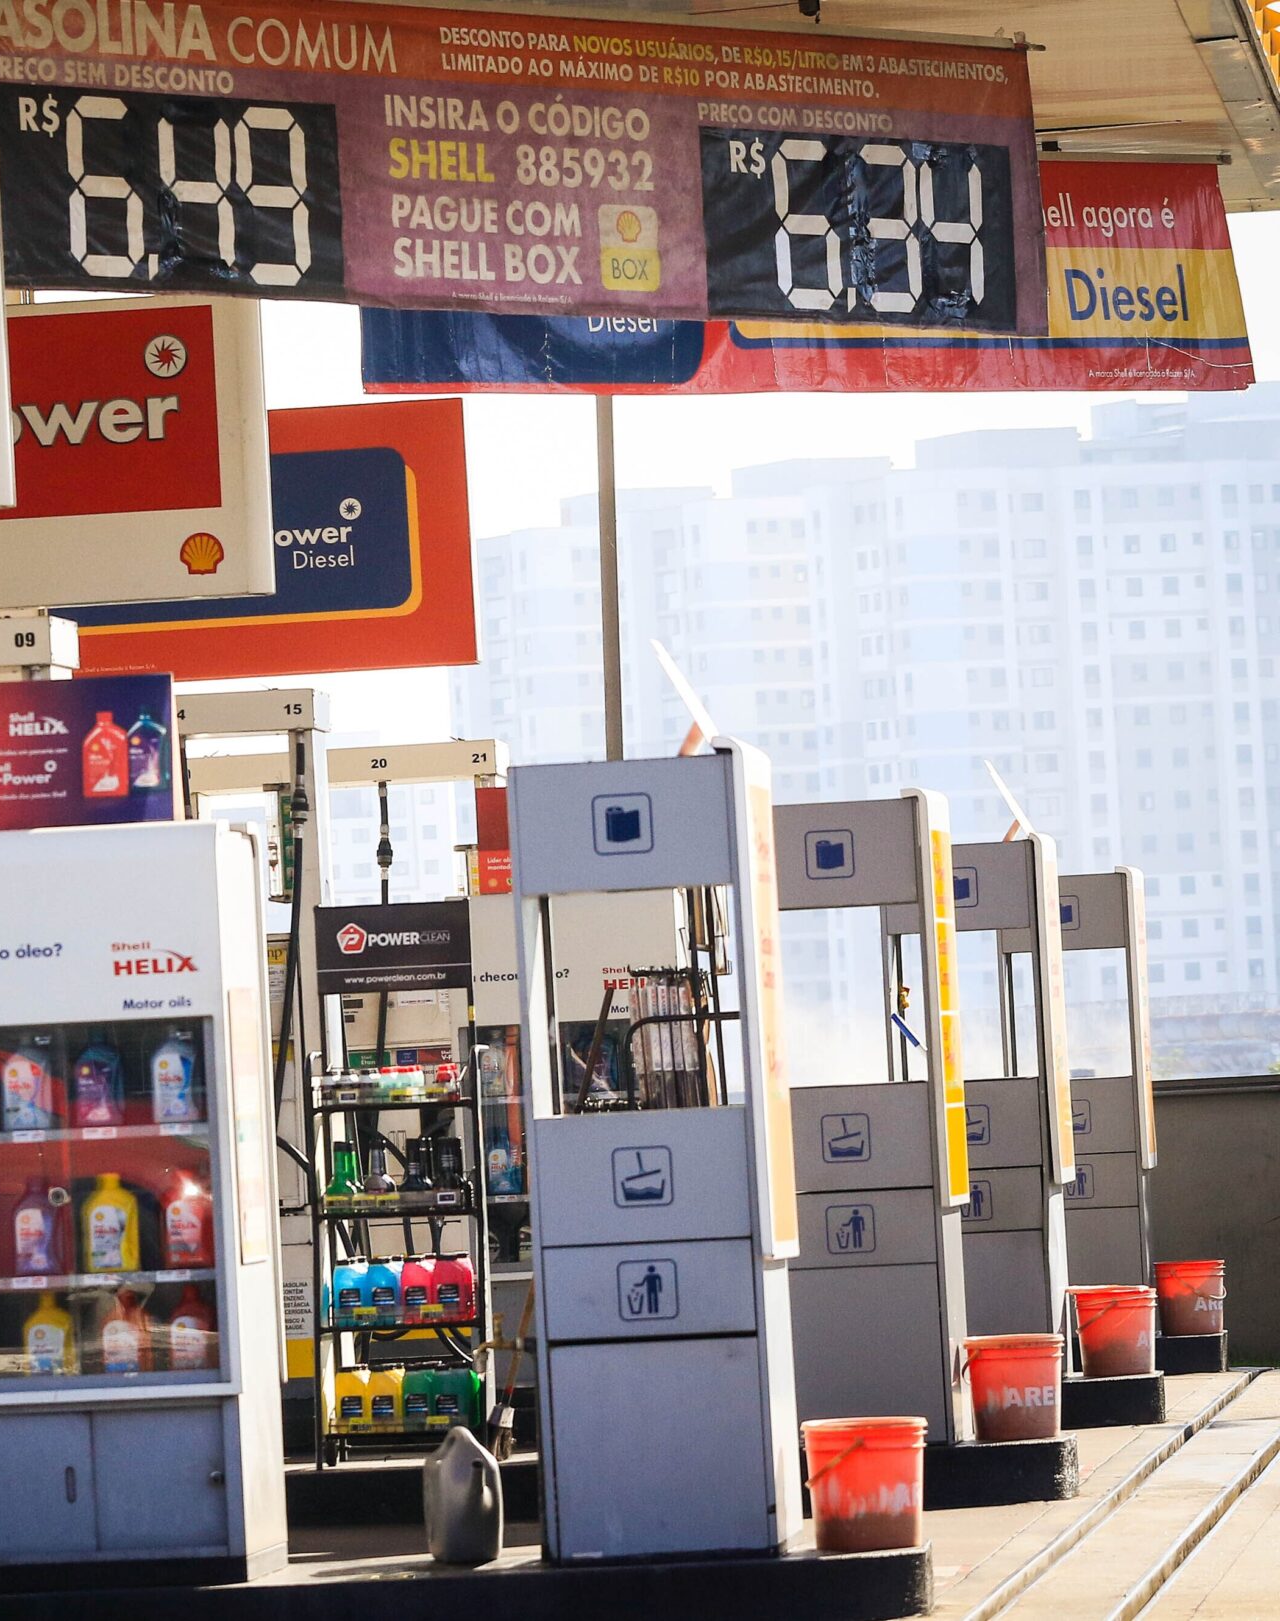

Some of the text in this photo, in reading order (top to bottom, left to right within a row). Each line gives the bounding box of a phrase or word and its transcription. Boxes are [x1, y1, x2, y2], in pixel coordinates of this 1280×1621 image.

[227, 16, 397, 73] COMUM
[440, 27, 524, 49] DESCONTO
[528, 33, 571, 52] PARA
[574, 36, 632, 57] NOVOS
[635, 37, 719, 64] USUÁRIOS,
[722, 46, 741, 63] DE
[842, 54, 864, 72] EM
[867, 55, 875, 72] 3
[878, 56, 1009, 85] ABASTECIMENTOS,
[64, 60, 107, 86] SEM
[114, 65, 234, 94] DESCONTO
[441, 53, 880, 99] LIMITADO AO MÁXIMO DE R$10 POR ABASTECIMENTO.
[384, 93, 650, 142] INSIRA O CÓDIGO
[697, 102, 893, 133] PREÇO COM DESCONTO
[388, 137, 655, 192] SHELL 885932
[18, 93, 311, 287] R$ 6,49
[391, 194, 582, 238] PAGUE COM
[729, 137, 984, 313] R$ 6,34
[1082, 203, 1154, 237] agora
[1161, 197, 1175, 228] é
[393, 237, 583, 285] SHELL BOX
[611, 258, 649, 281] BOX
[1064, 264, 1189, 321] Diesel
[274, 526, 352, 547] ower
[293, 544, 354, 569] Diesel
[14, 632, 35, 649] 09
[9, 711, 36, 723] Shell
[283, 703, 302, 715] 15
[9, 718, 69, 738] HELIX
[371, 758, 387, 769] 20
[472, 752, 487, 763] 21
[111, 942, 150, 951] Shell
[368, 932, 450, 947] POWERCLEAN
[0, 951, 9, 960] o
[113, 954, 199, 976] HELIX
[344, 972, 446, 984] www.powerclean.com.br
[123, 995, 192, 1011] Motor oils
